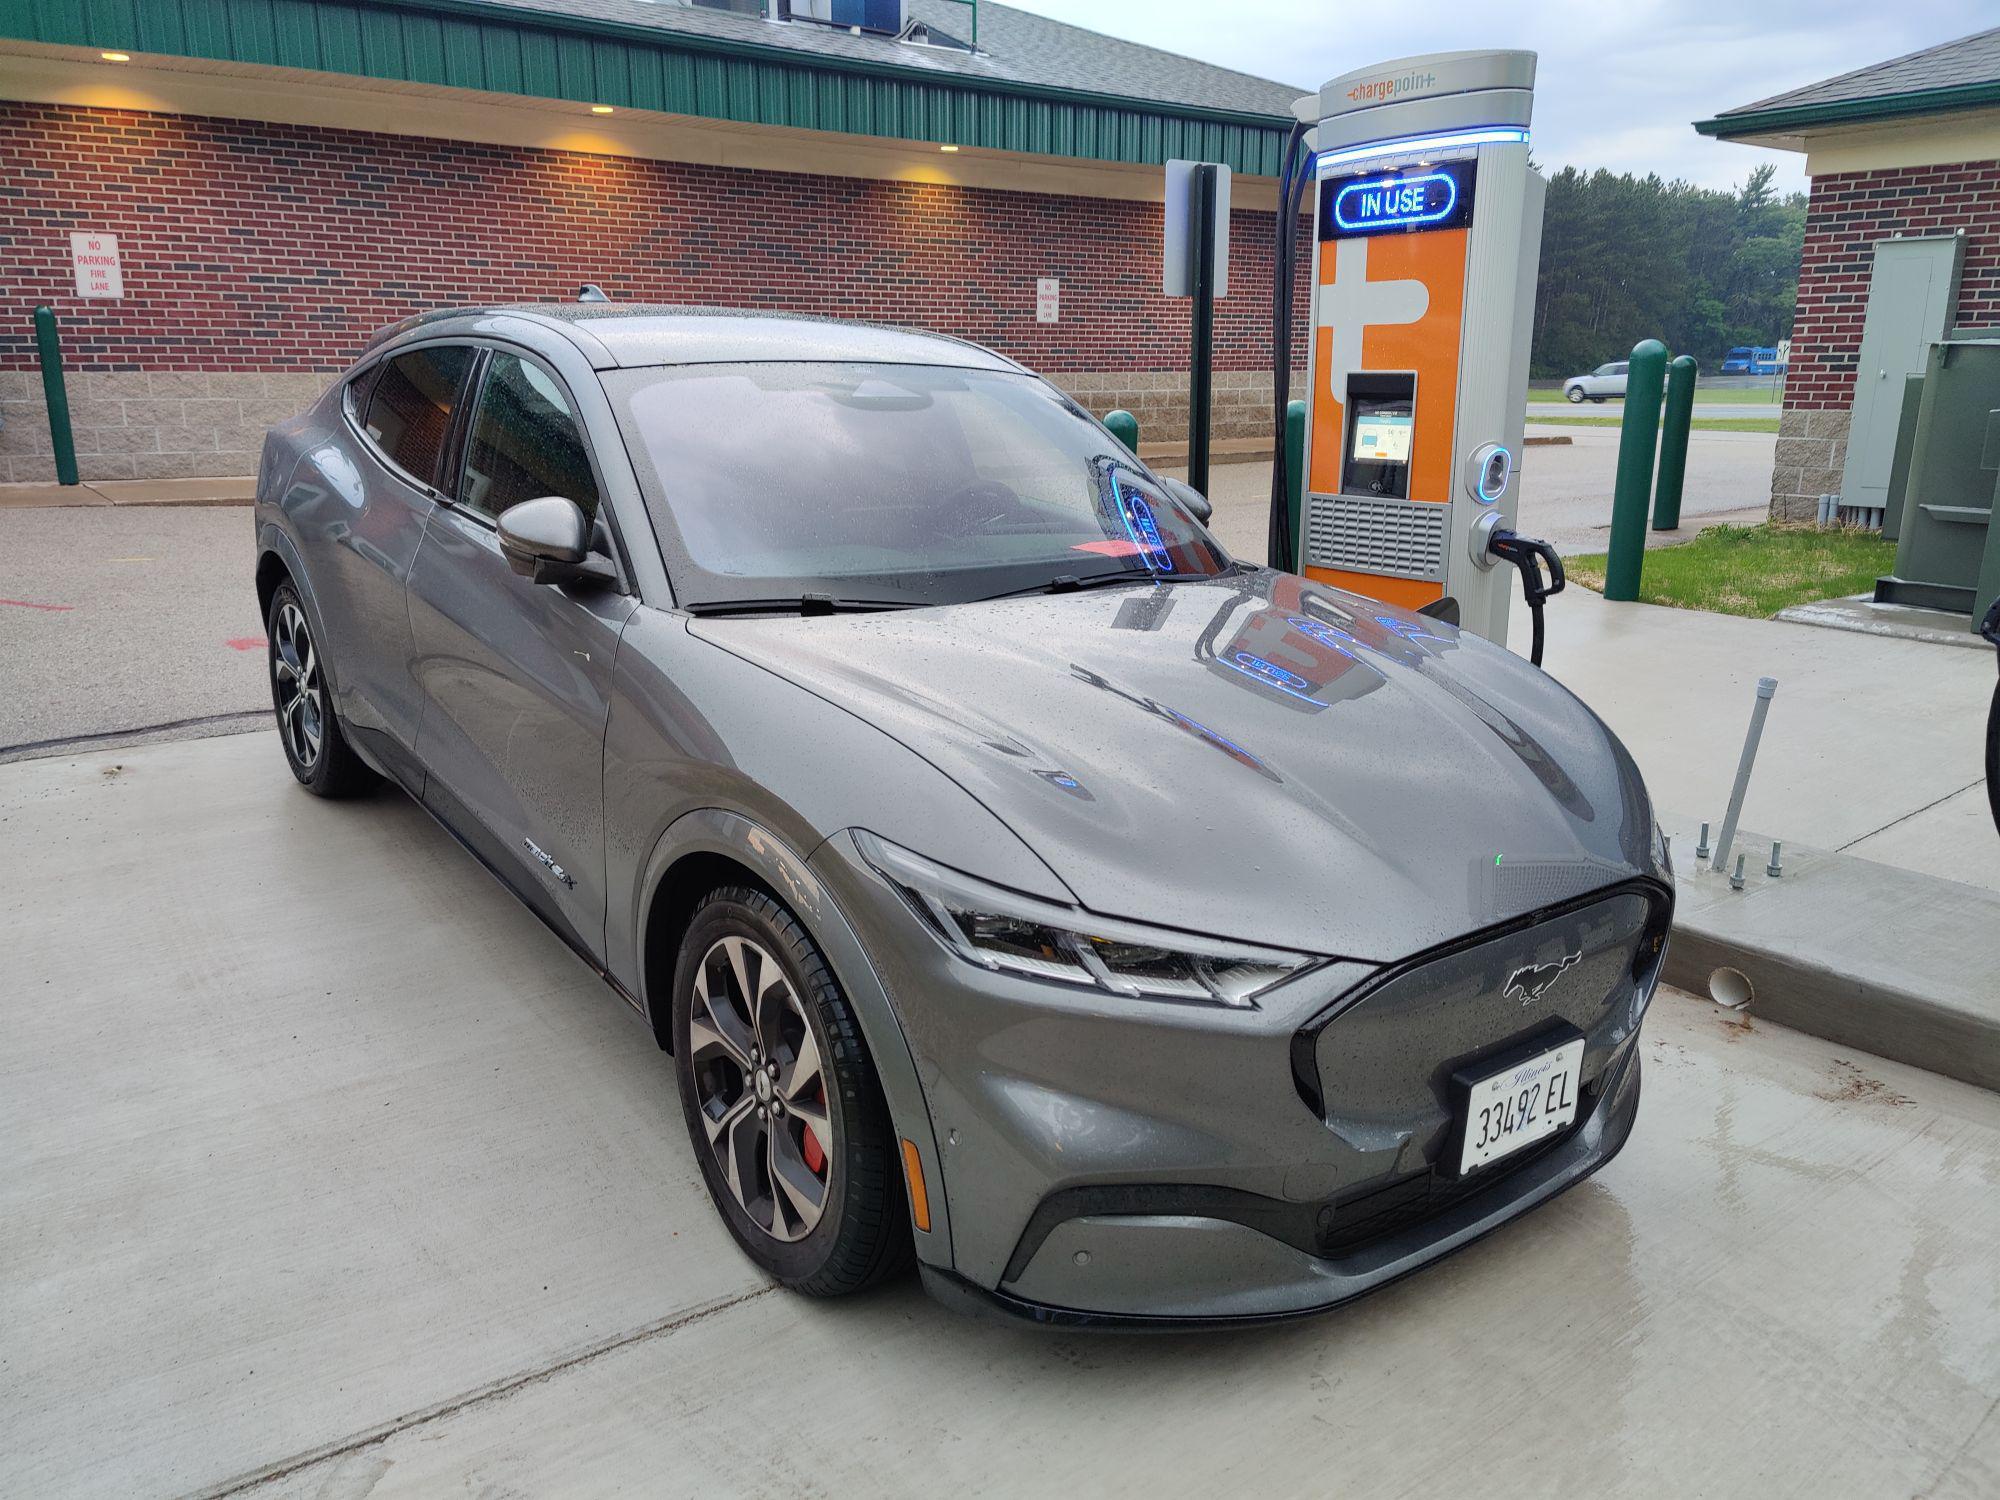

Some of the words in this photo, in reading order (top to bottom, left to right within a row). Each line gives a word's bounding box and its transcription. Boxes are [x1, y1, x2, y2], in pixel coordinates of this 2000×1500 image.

[1361, 191, 1381, 217] IN
[1385, 186, 1425, 214] USE
[88, 240, 101, 251] NO
[77, 255, 116, 266] PARKING
[90, 270, 106, 279] FIRE
[90, 281, 110, 291] LANE
[1506, 1060, 1553, 1089] Illinois
[1475, 1082, 1541, 1149] 33492
[1545, 1070, 1572, 1115] EL
